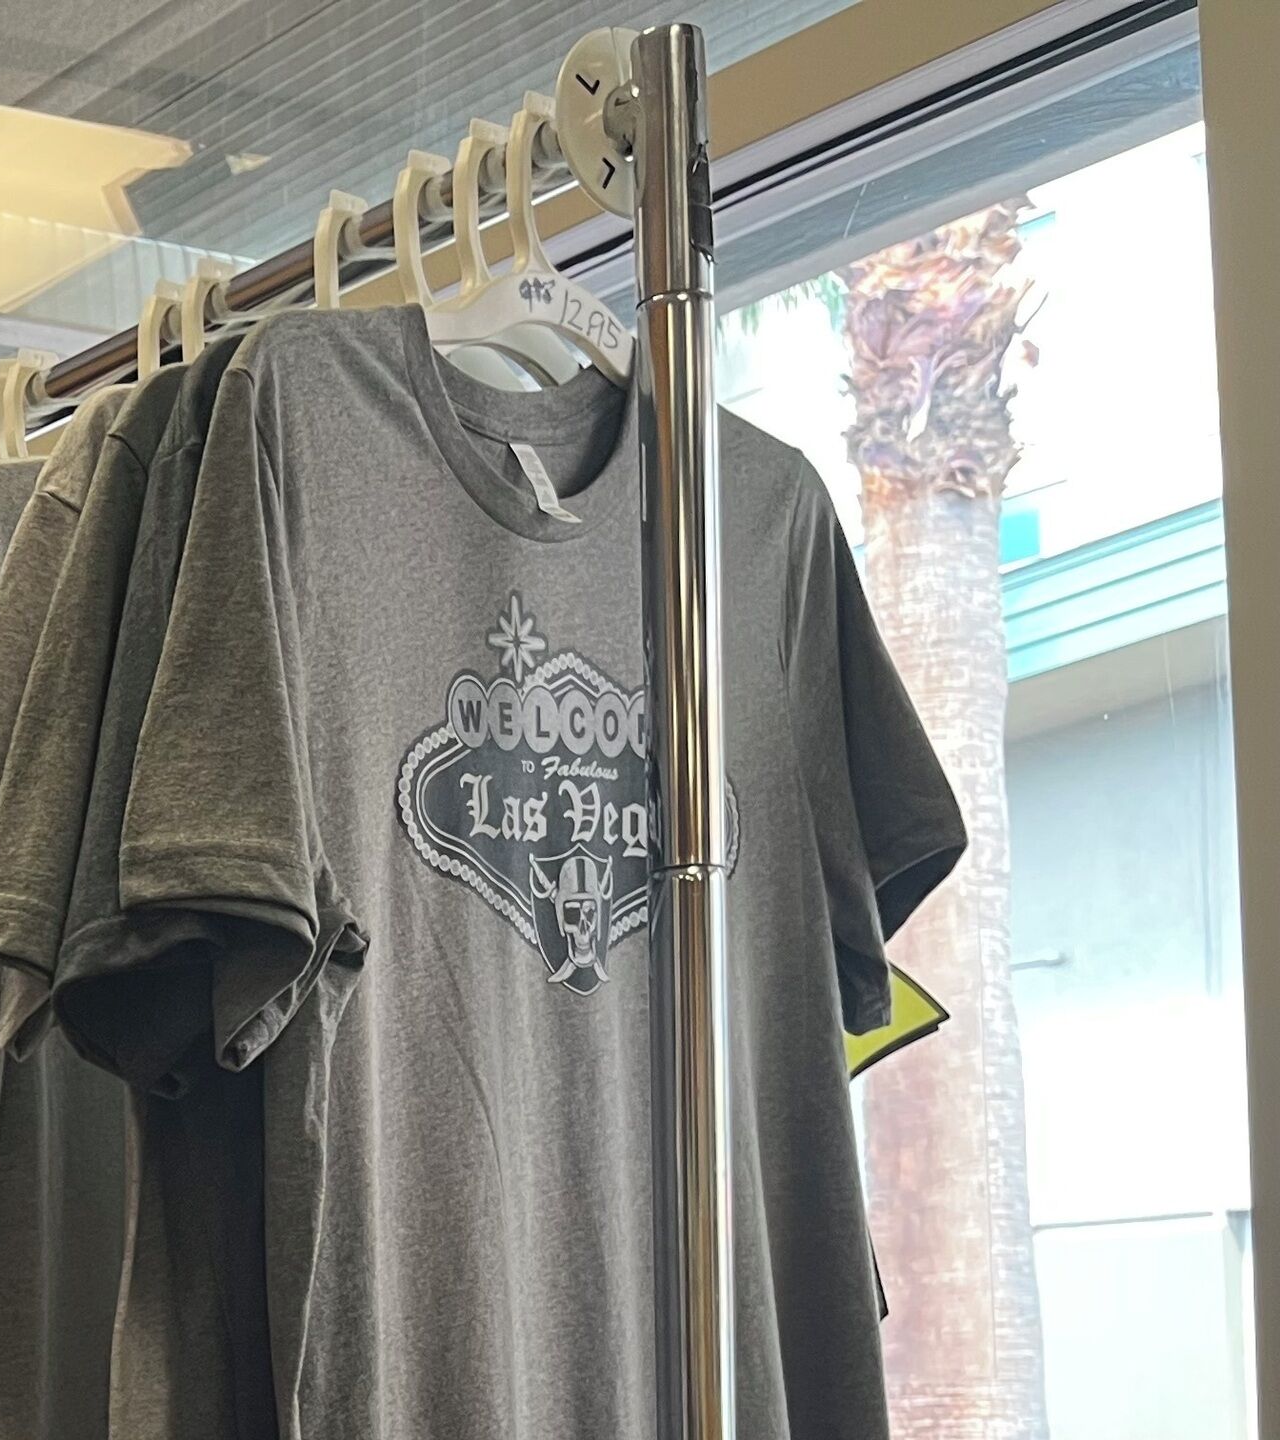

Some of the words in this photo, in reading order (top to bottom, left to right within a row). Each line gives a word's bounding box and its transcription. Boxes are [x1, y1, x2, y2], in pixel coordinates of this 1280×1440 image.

[576, 74, 600, 95] L
[540, 755, 619, 781] Fabulous
[459, 772, 549, 843] Las
[558, 779, 649, 858] Veg
